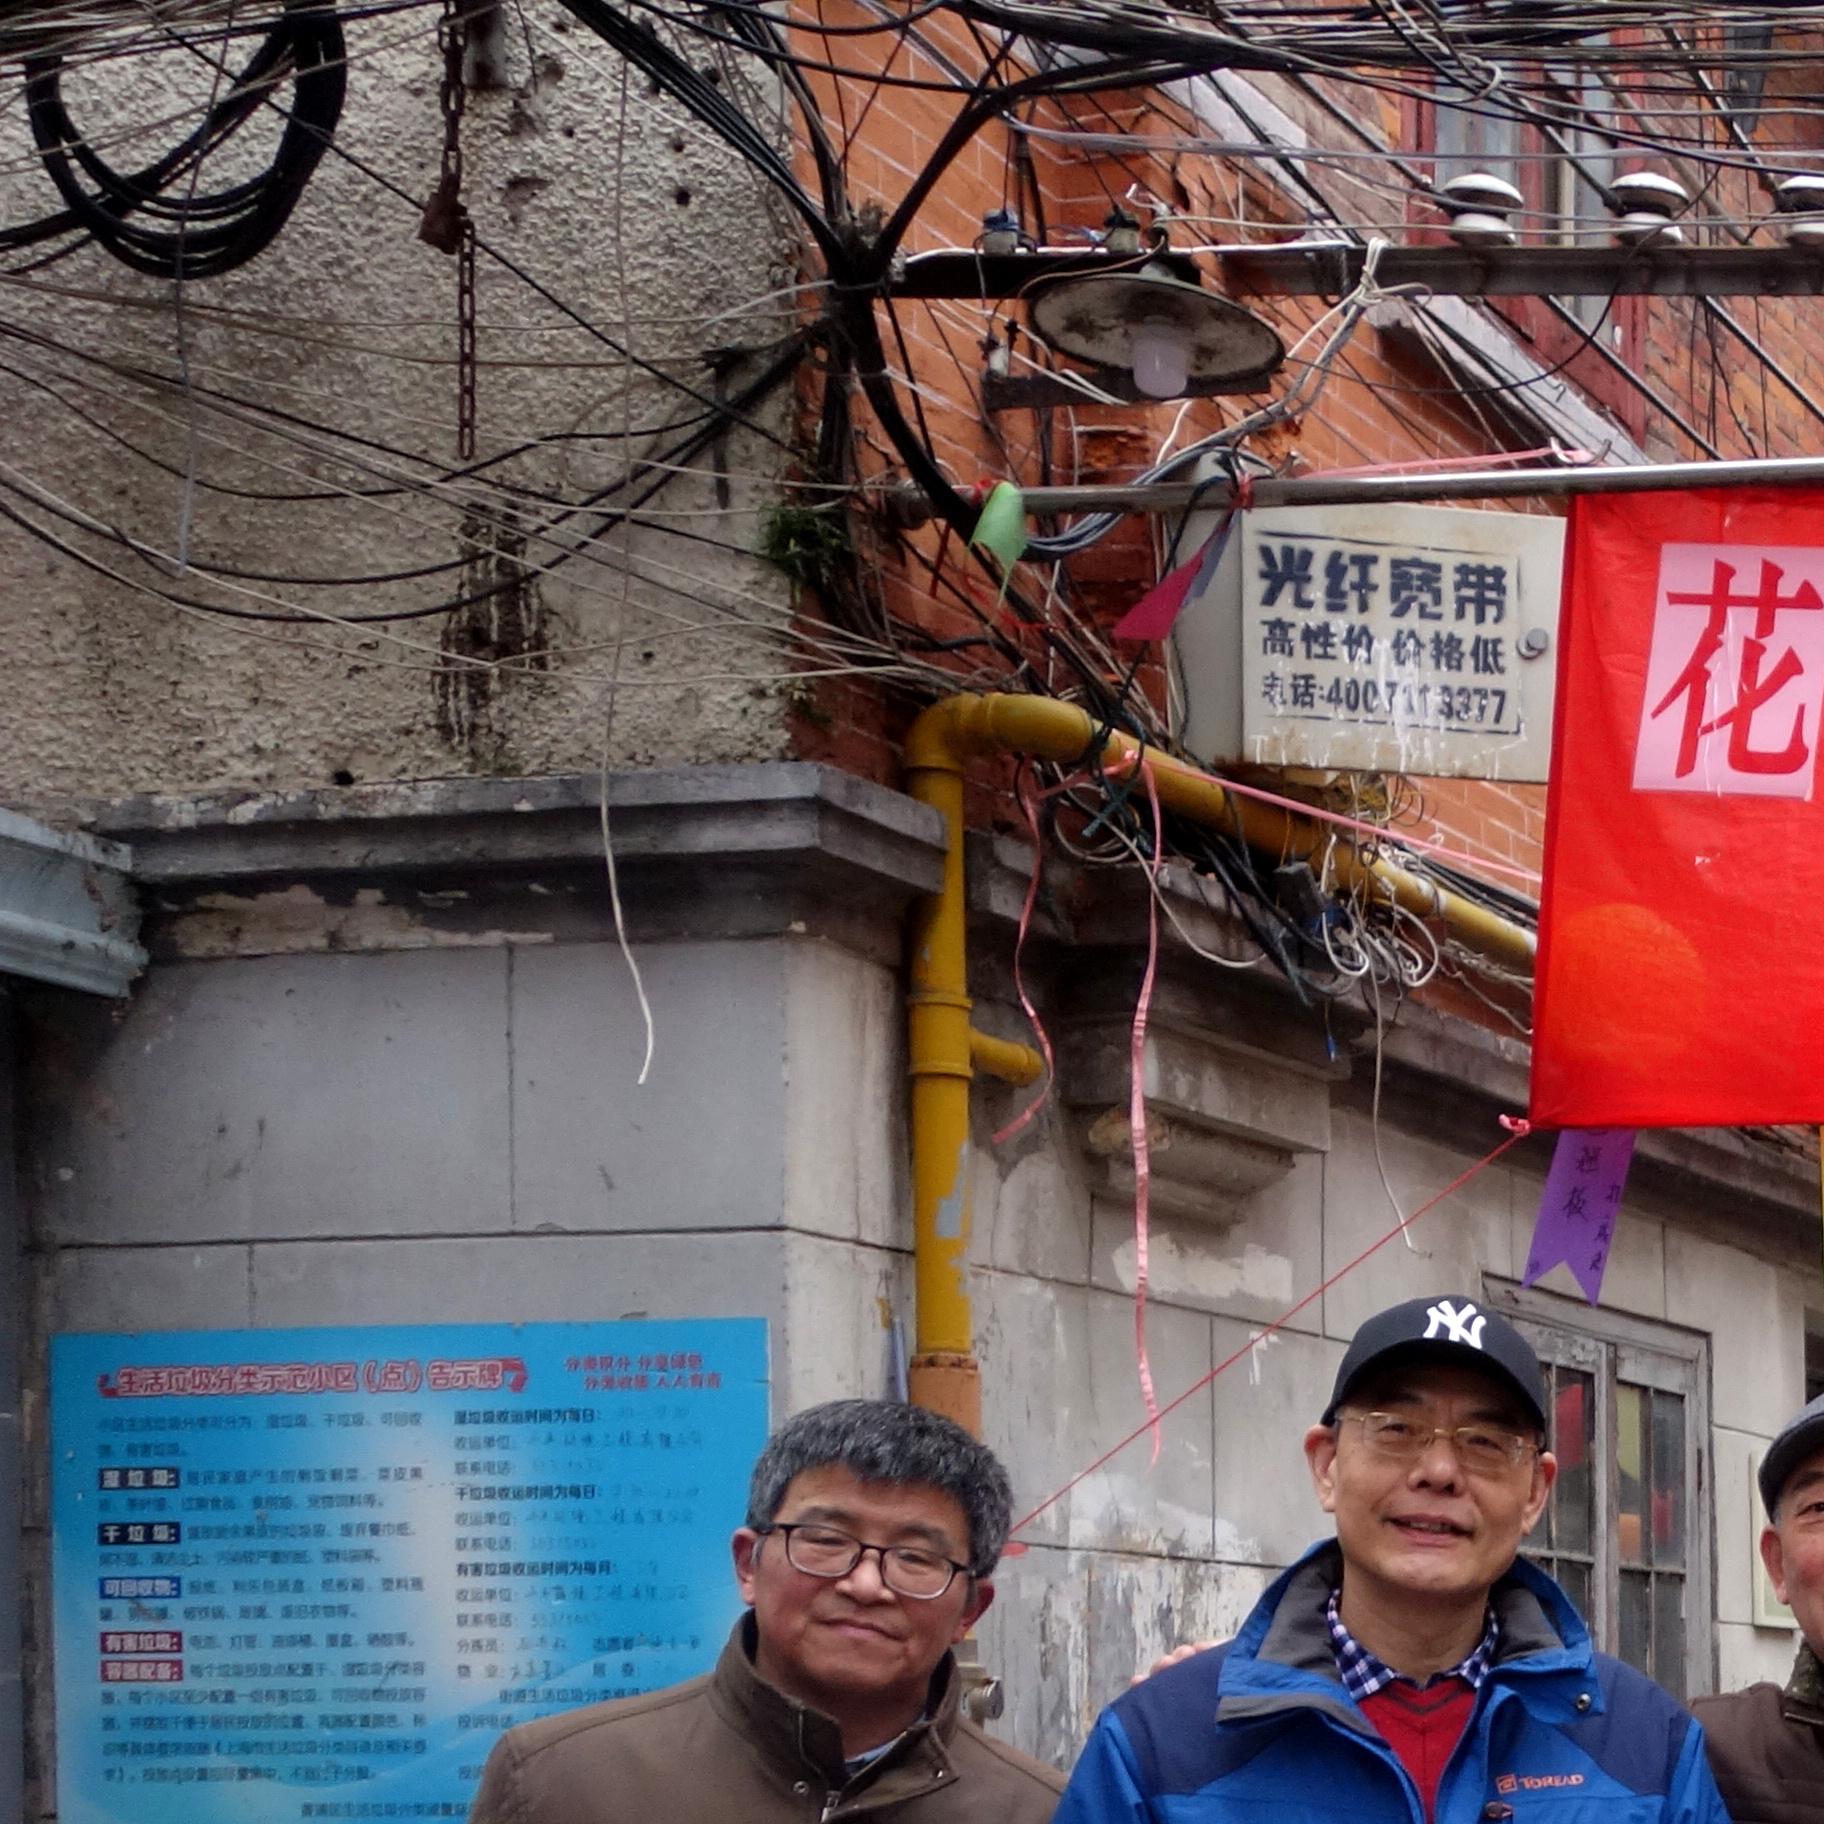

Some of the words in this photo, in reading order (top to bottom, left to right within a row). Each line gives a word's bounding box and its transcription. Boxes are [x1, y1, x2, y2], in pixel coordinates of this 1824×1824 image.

[1259, 545, 1507, 624] 光纤宽带
[1391, 626, 1506, 676] 价格低
[1423, 1301, 1487, 1350] NY
